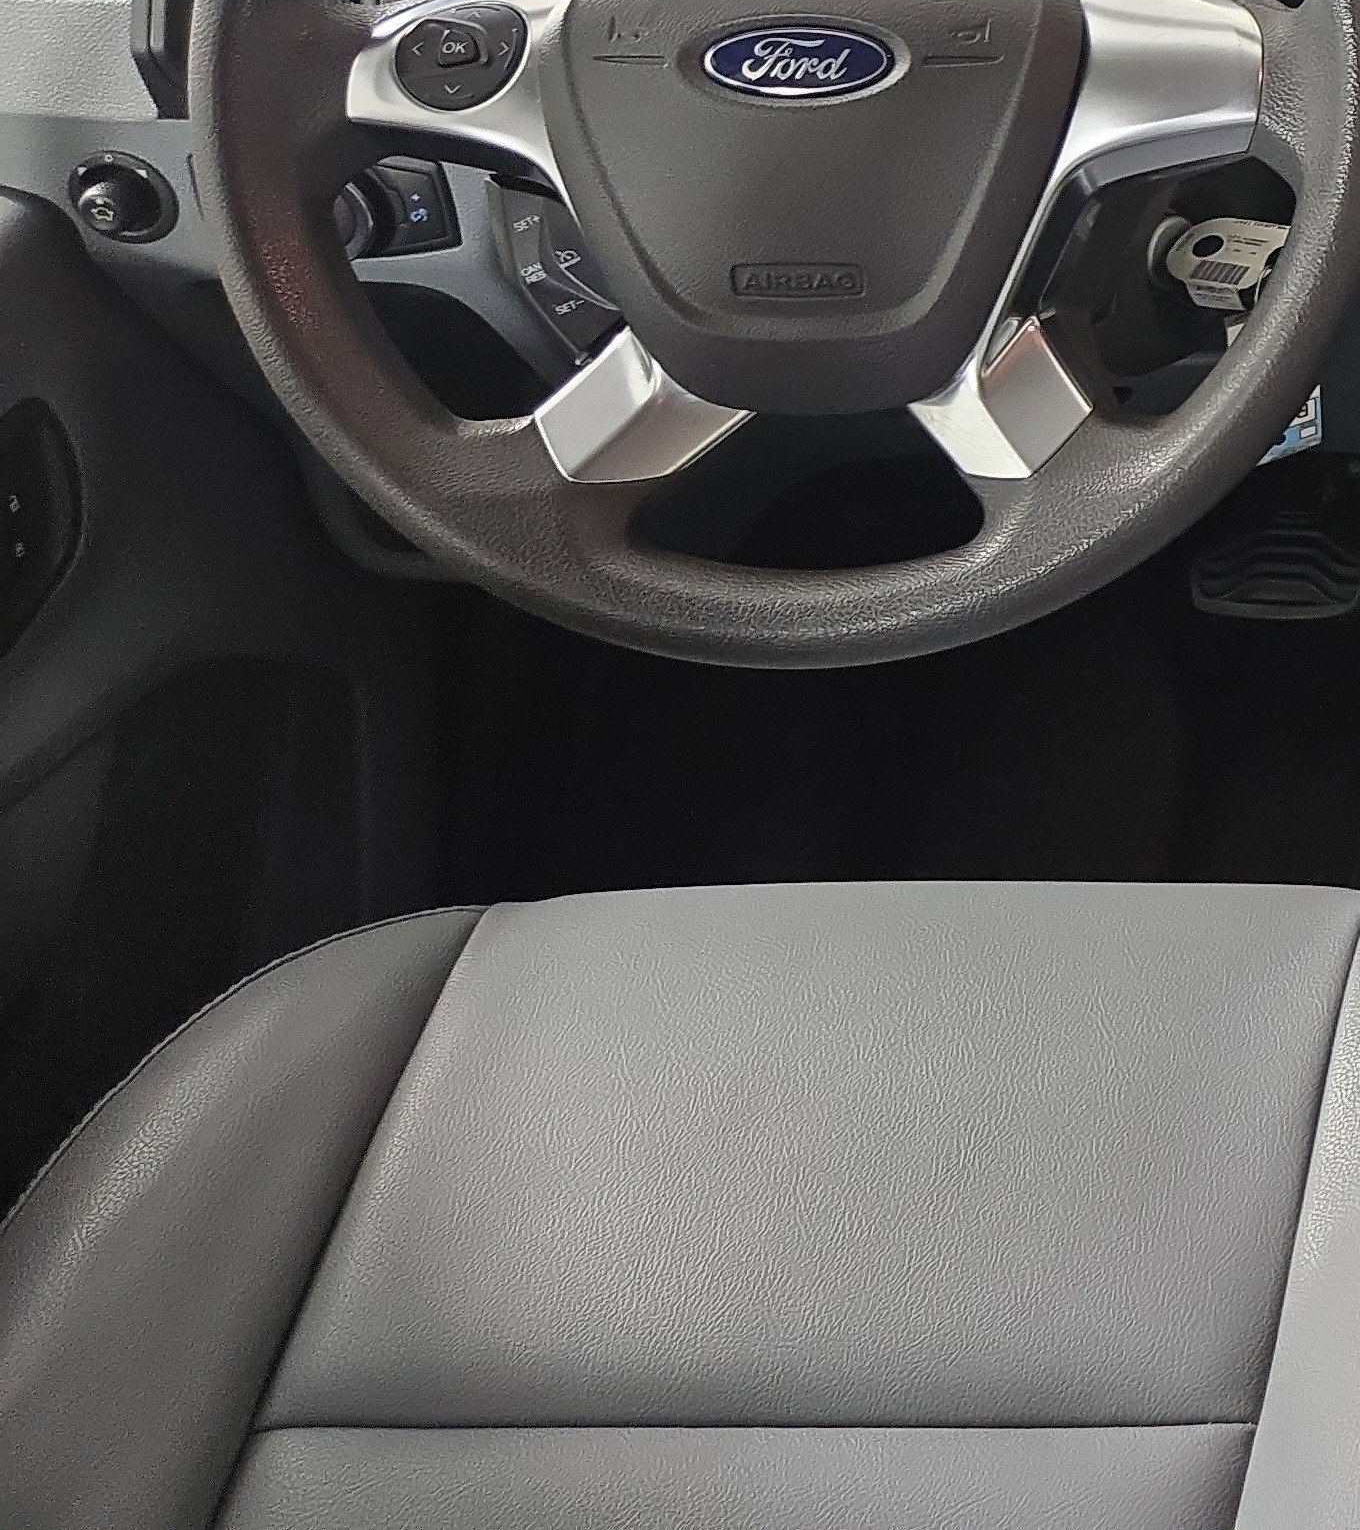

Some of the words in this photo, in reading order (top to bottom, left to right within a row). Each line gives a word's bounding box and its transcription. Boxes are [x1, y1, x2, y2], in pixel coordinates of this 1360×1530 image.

[441, 41, 467, 54] OK
[742, 37, 851, 81] Ford
[742, 272, 855, 291] AIRBAG
